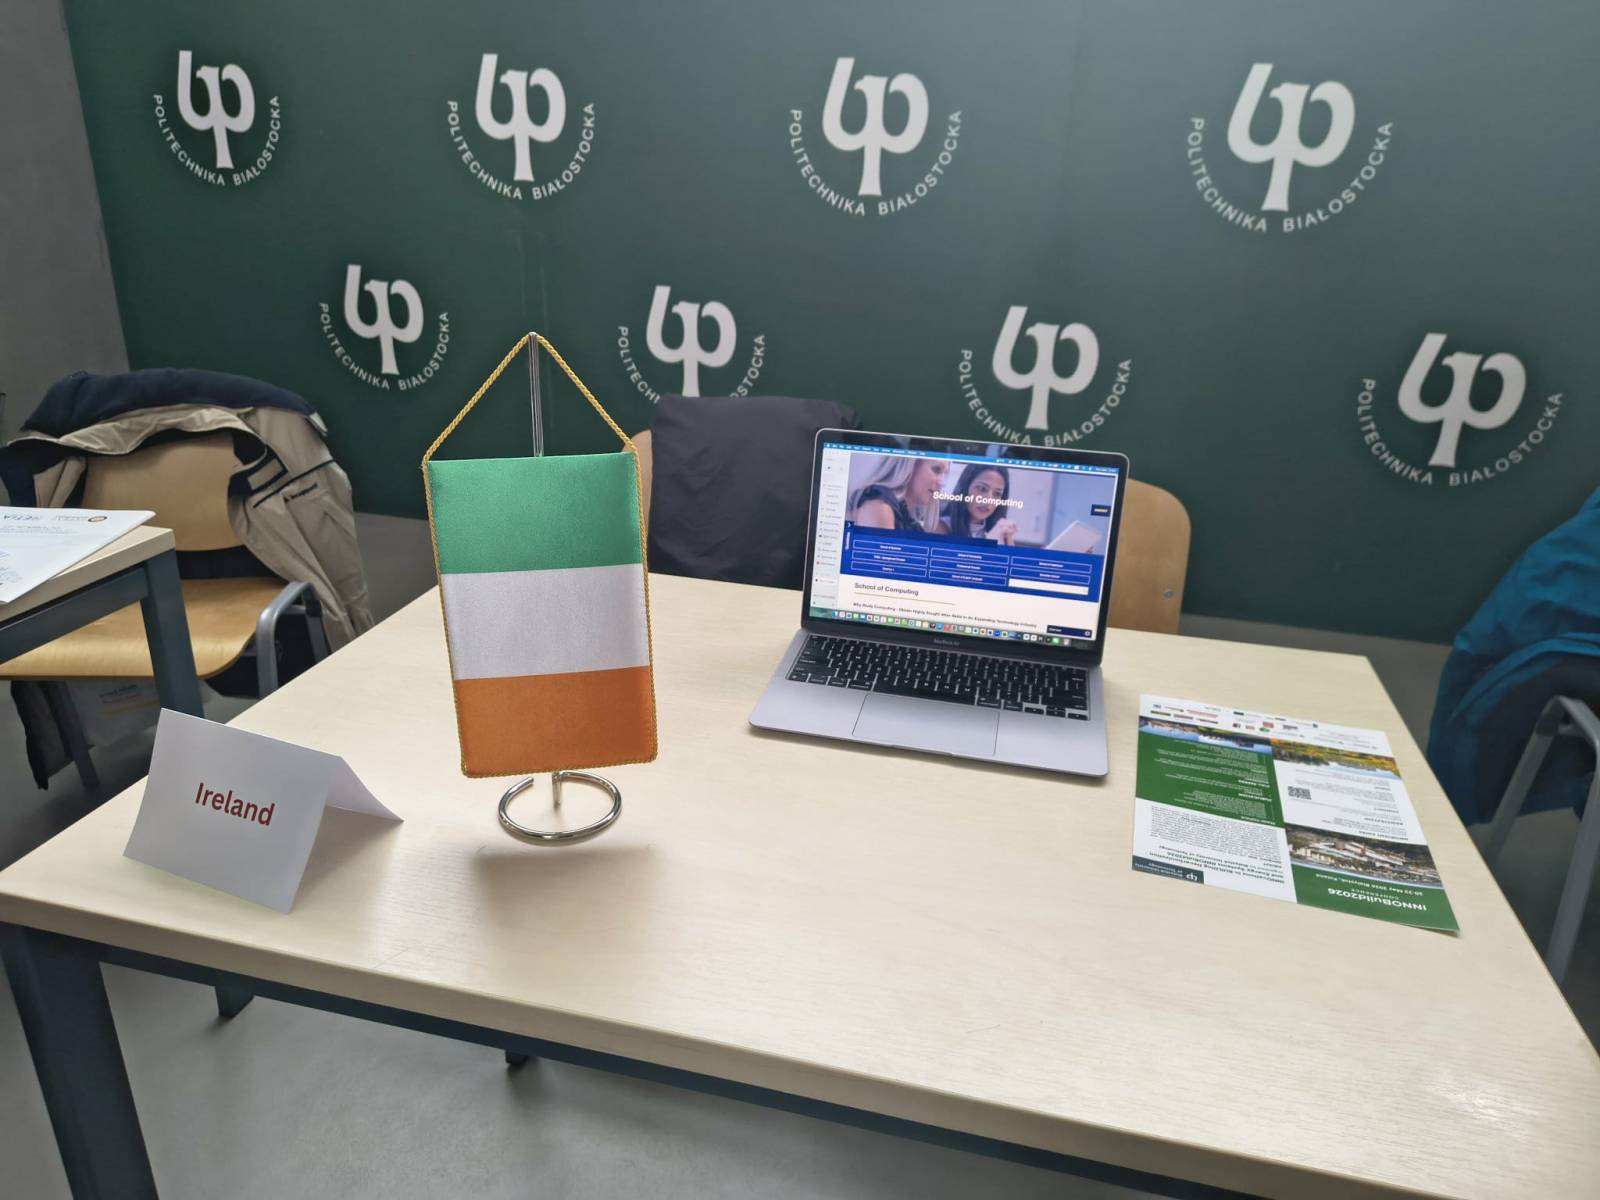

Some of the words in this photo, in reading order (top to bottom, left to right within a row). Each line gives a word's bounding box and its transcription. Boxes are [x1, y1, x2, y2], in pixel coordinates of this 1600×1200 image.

[153, 94, 226, 186] POLITECHNIKA
[232, 95, 281, 186] BIAŁOSTOCKA
[447, 100, 523, 200] POLITECHNIKA
[532, 103, 595, 200] BIAŁOSTOCKA
[789, 109, 865, 216] POLITECHNIKA
[878, 110, 963, 216] BIAŁOSTOCKA
[1187, 117, 1268, 233] POLITECHNIKA
[1282, 122, 1394, 233] BIAŁOSTOCKA
[319, 302, 390, 391] POLITECHNIKA
[399, 312, 450, 391] BIAŁOSTOCKA
[617, 326, 661, 404] POLITECH
[729, 334, 765, 400] STOCKA
[959, 349, 1031, 446] POLITECHNIKA
[1044, 359, 1132, 447] BIAŁOSTOCKA
[1357, 378, 1433, 486] POLITECHNIKA
[1449, 393, 1563, 487] BIAŁOSTOCKA
[932, 491, 963, 502] School
[965, 495, 974, 503] of
[975, 495, 1024, 509] Computing
[854, 583, 876, 591] School
[885, 586, 919, 596] Computing
[195, 782, 275, 826] Ireland
[1328, 888, 1427, 911] INNOBuild2026
